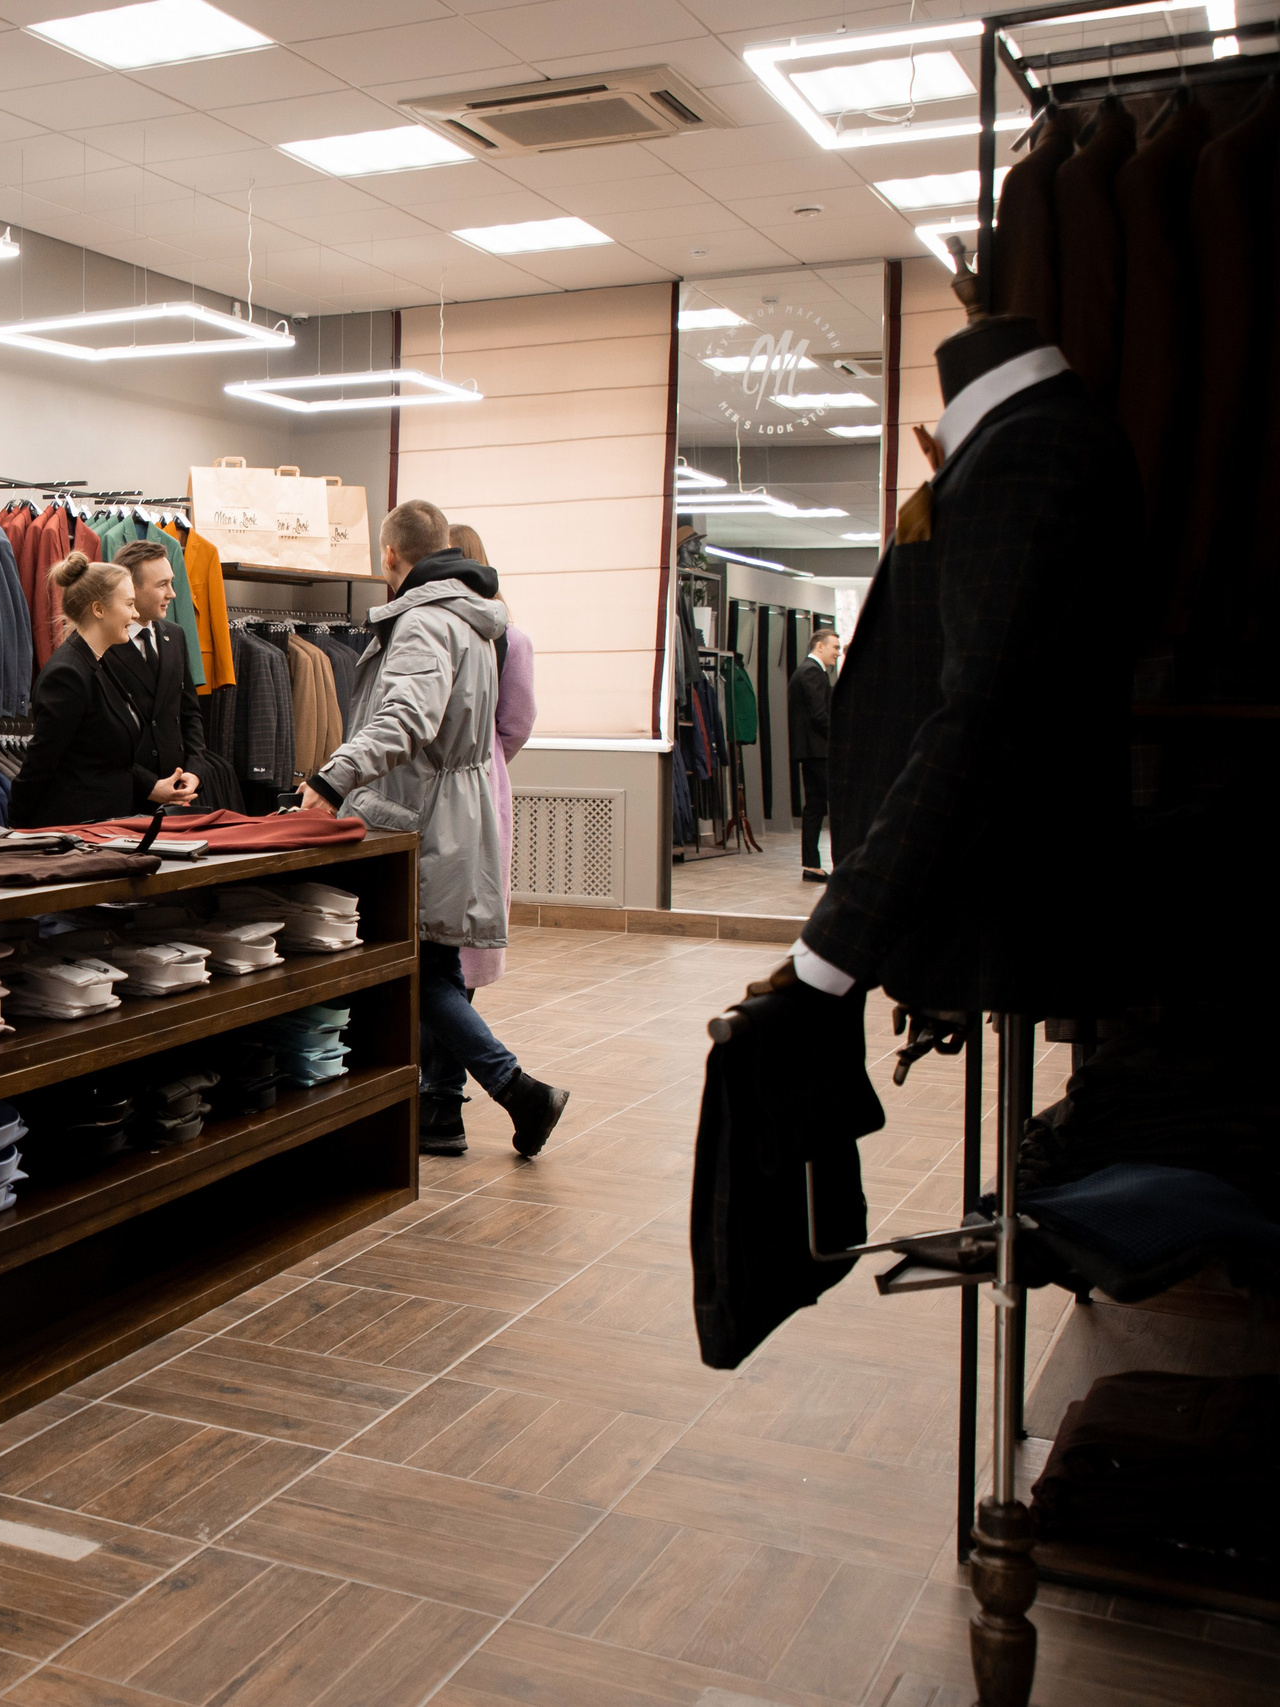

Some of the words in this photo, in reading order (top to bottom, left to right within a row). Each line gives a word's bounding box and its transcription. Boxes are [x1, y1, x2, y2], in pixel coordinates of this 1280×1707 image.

[785, 305, 841, 349] МАГАЗИН
[719, 401, 751, 430] MEN'S
[758, 423, 794, 435] LOOK
[277, 518, 291, 531] en's
